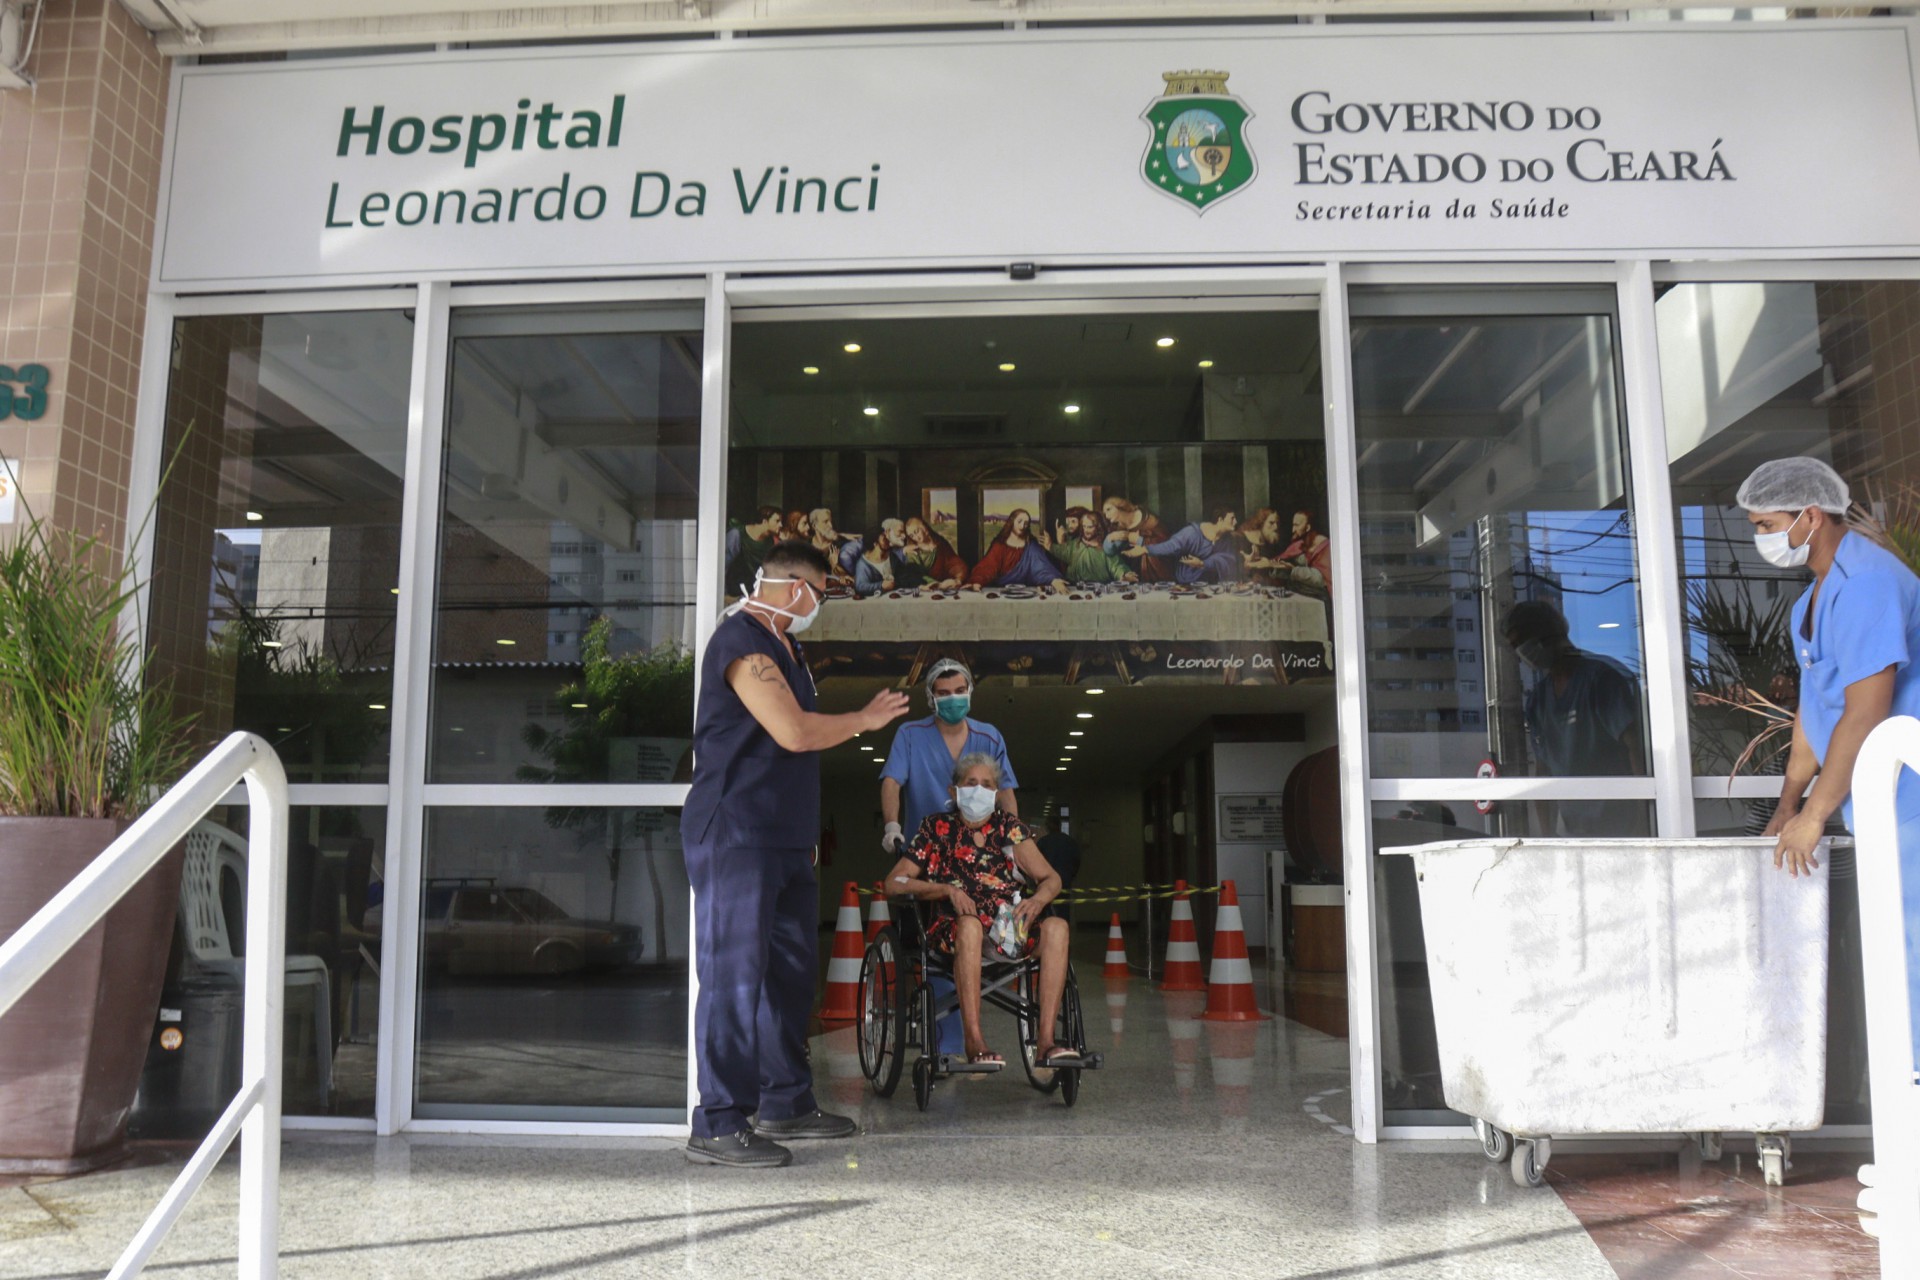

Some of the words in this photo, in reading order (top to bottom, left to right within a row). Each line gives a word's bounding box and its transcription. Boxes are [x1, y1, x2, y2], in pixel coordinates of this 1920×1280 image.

[336, 94, 626, 168] Hospital
[1291, 91, 1534, 134] GOVERNO
[1547, 106, 1602, 130] DO
[1293, 141, 1487, 185] ESTADO
[1498, 158, 1554, 182] DO
[1566, 137, 1737, 183] CEARÁ
[324, 172, 607, 229] Leonardo
[630, 171, 707, 218] Da
[733, 163, 881, 215] Vinci
[1295, 200, 1431, 220] Secretaria
[1446, 198, 1477, 219] da
[1490, 197, 1570, 219] Saúde
[1166, 653, 1245, 669] Leonardo
[1252, 653, 1274, 668] Da
[1281, 652, 1321, 668] Vinci
